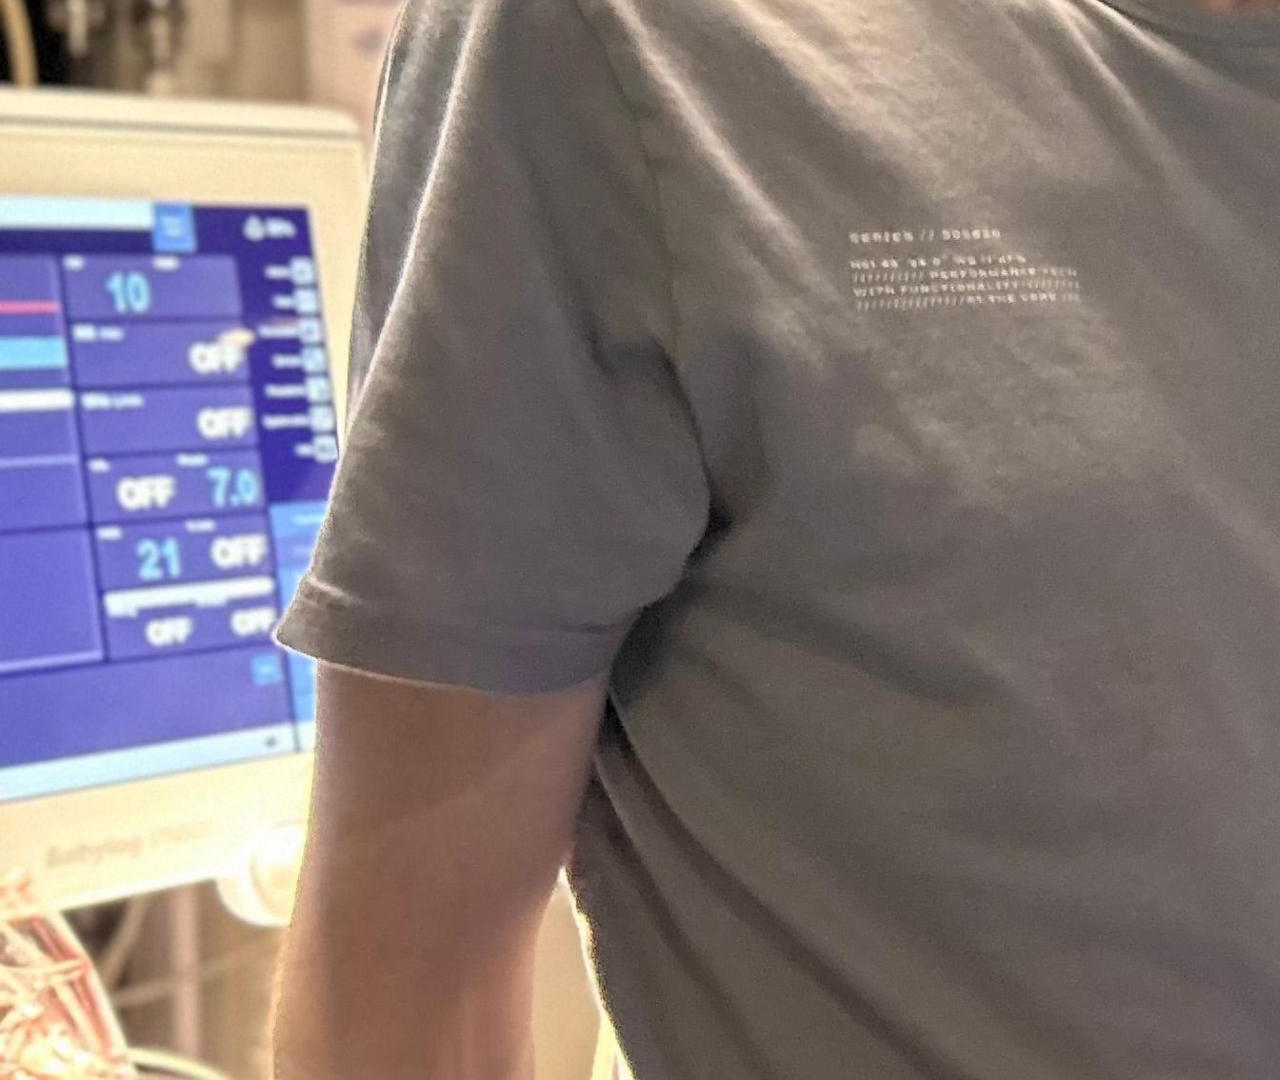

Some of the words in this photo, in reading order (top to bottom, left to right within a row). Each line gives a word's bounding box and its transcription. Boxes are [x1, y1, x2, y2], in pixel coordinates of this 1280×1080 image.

[105, 271, 150, 315] 10
[188, 342, 243, 374] OFF
[197, 406, 251, 440] OFF
[117, 474, 175, 511] OFF
[136, 537, 181, 581] 21
[211, 533, 267, 570] OFF
[146, 616, 193, 648] OFF
[231, 606, 277, 638] OFF
